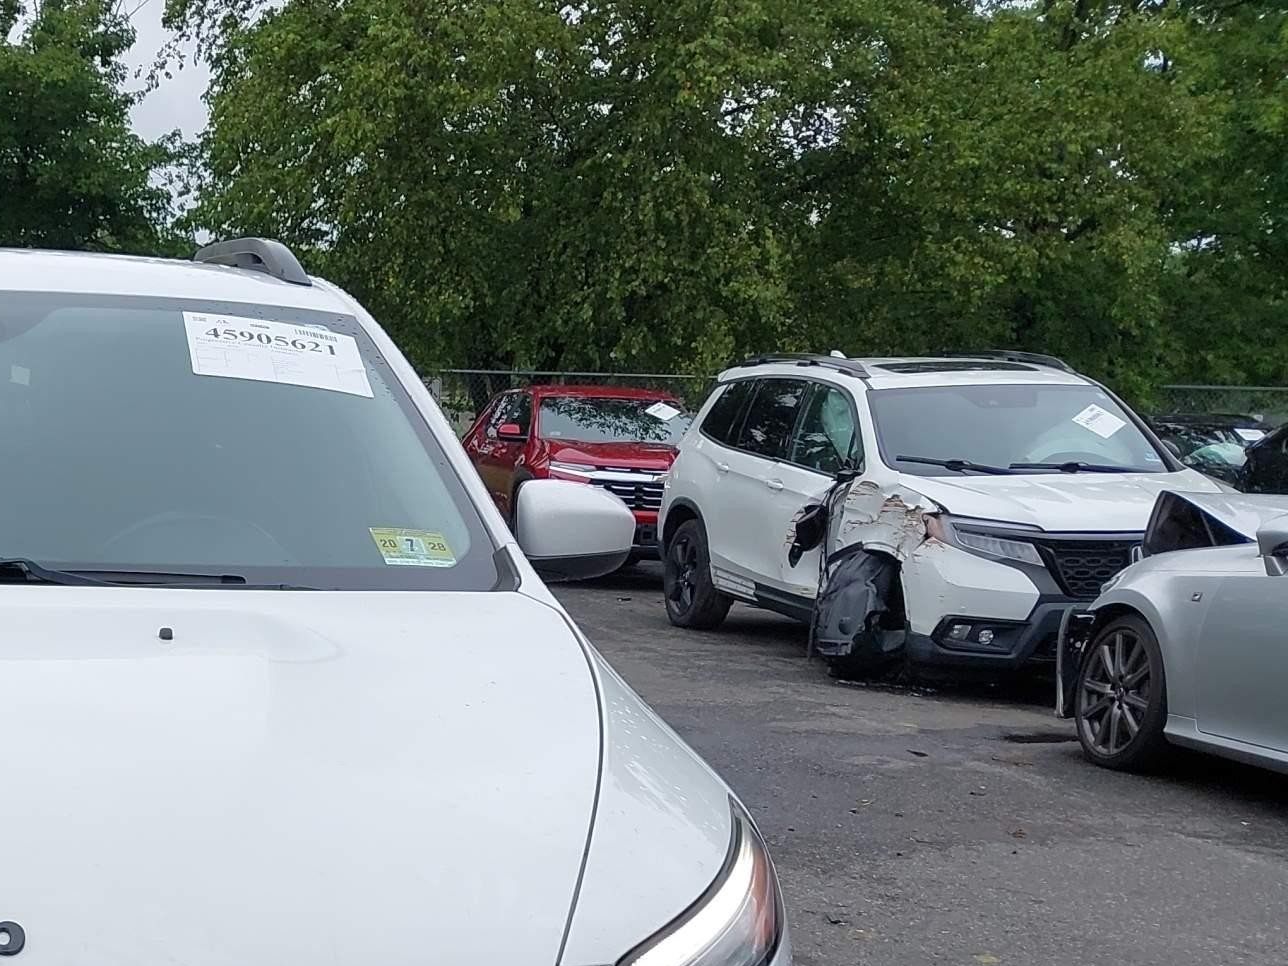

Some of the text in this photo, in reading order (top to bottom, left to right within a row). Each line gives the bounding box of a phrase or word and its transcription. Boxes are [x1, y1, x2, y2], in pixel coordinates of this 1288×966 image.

[204, 327, 336, 356] 45905621
[379, 538, 446, 552] 20 7 28
